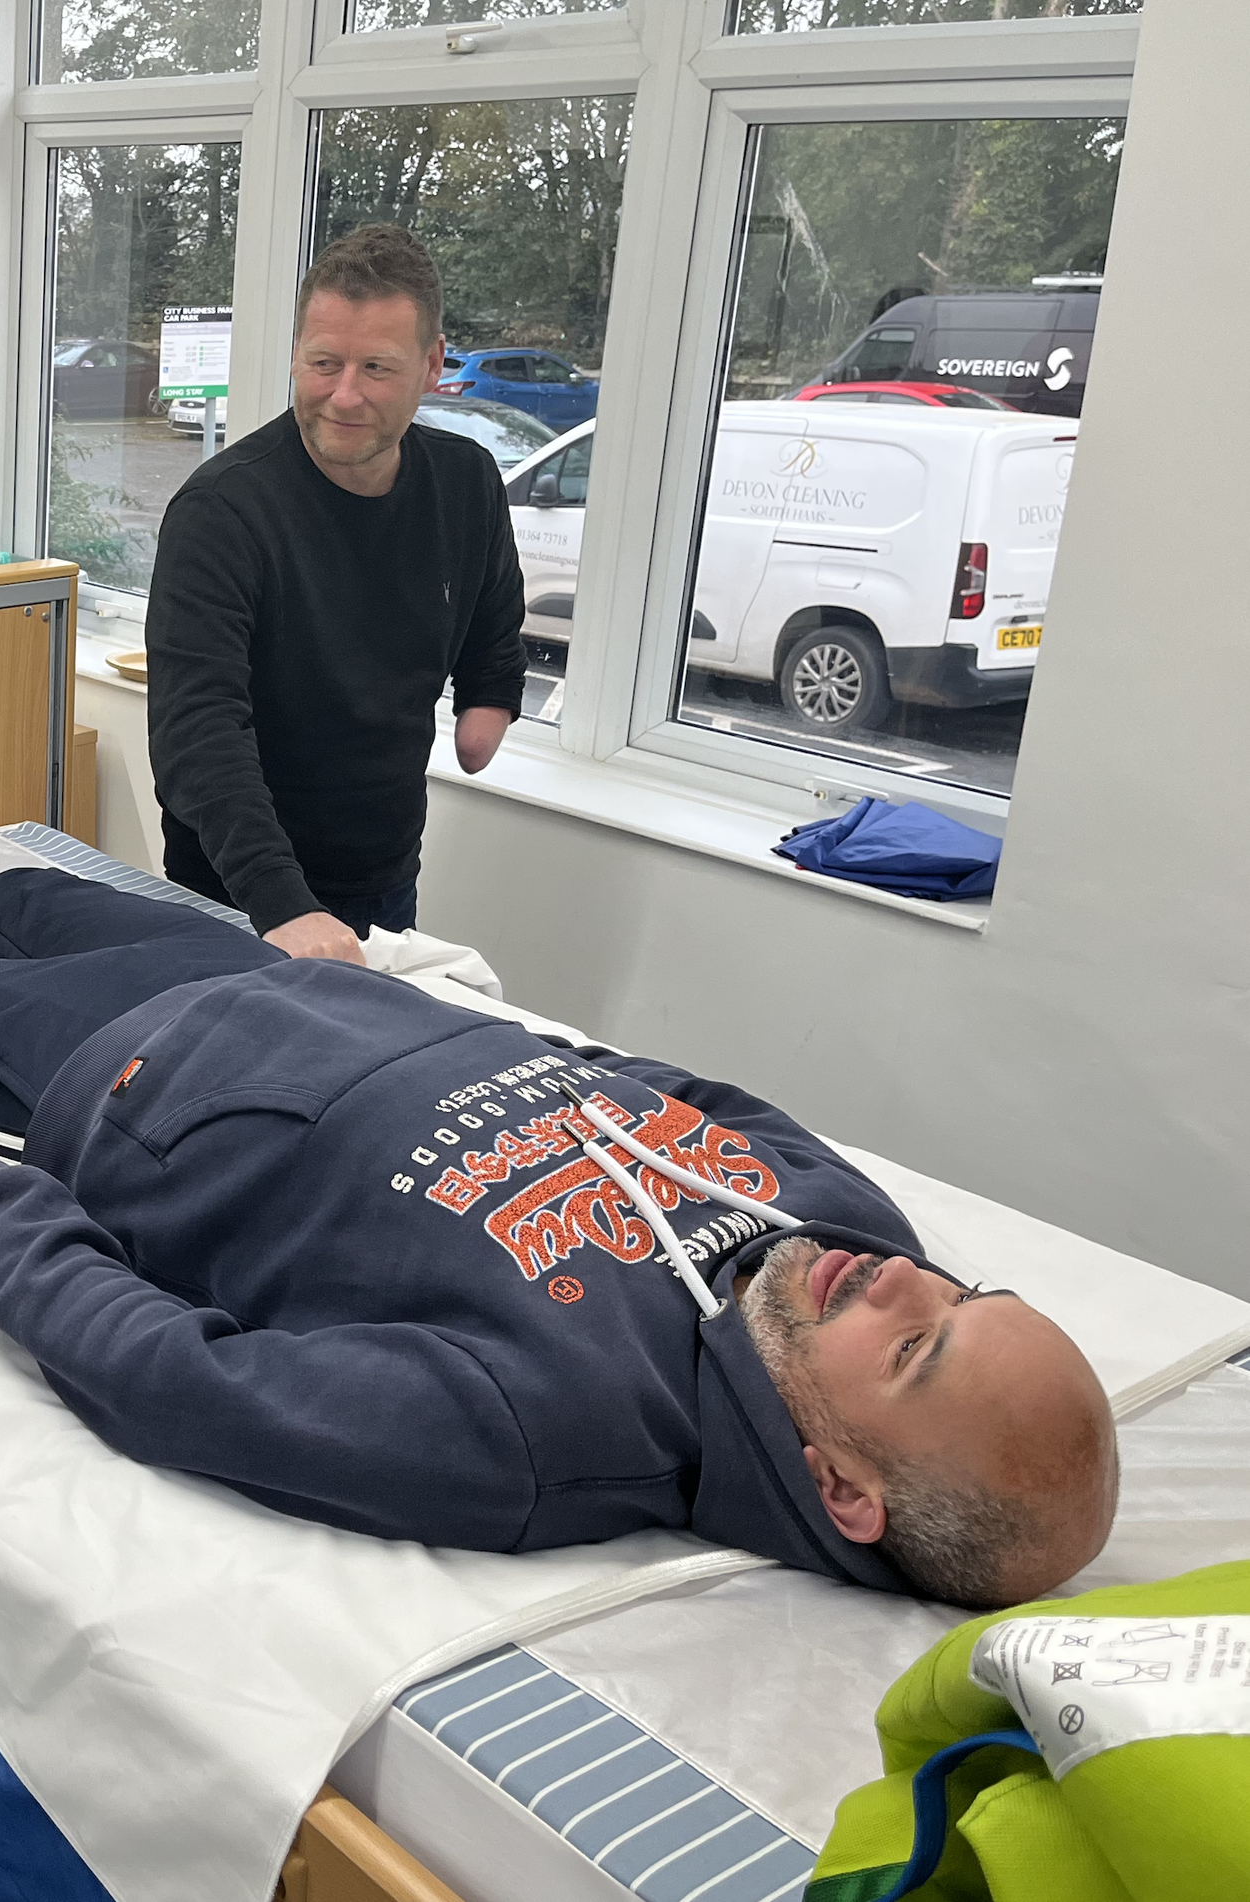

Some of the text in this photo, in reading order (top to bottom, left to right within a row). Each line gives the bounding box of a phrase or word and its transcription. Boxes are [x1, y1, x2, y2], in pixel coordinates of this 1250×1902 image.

[163, 307, 181, 315] CITY
[182, 306, 216, 314] BUSINESS
[937, 358, 1041, 377] SOVEREIGN
[162, 388, 204, 397] LONG STAY
[722, 479, 867, 510] DEVON CLEANING
[749, 504, 827, 523] SOUTH HAMS
[516, 528, 540, 541] 01364
[1002, 630, 1035, 647] CE70
[485, 1112, 780, 1282] SupeDry
